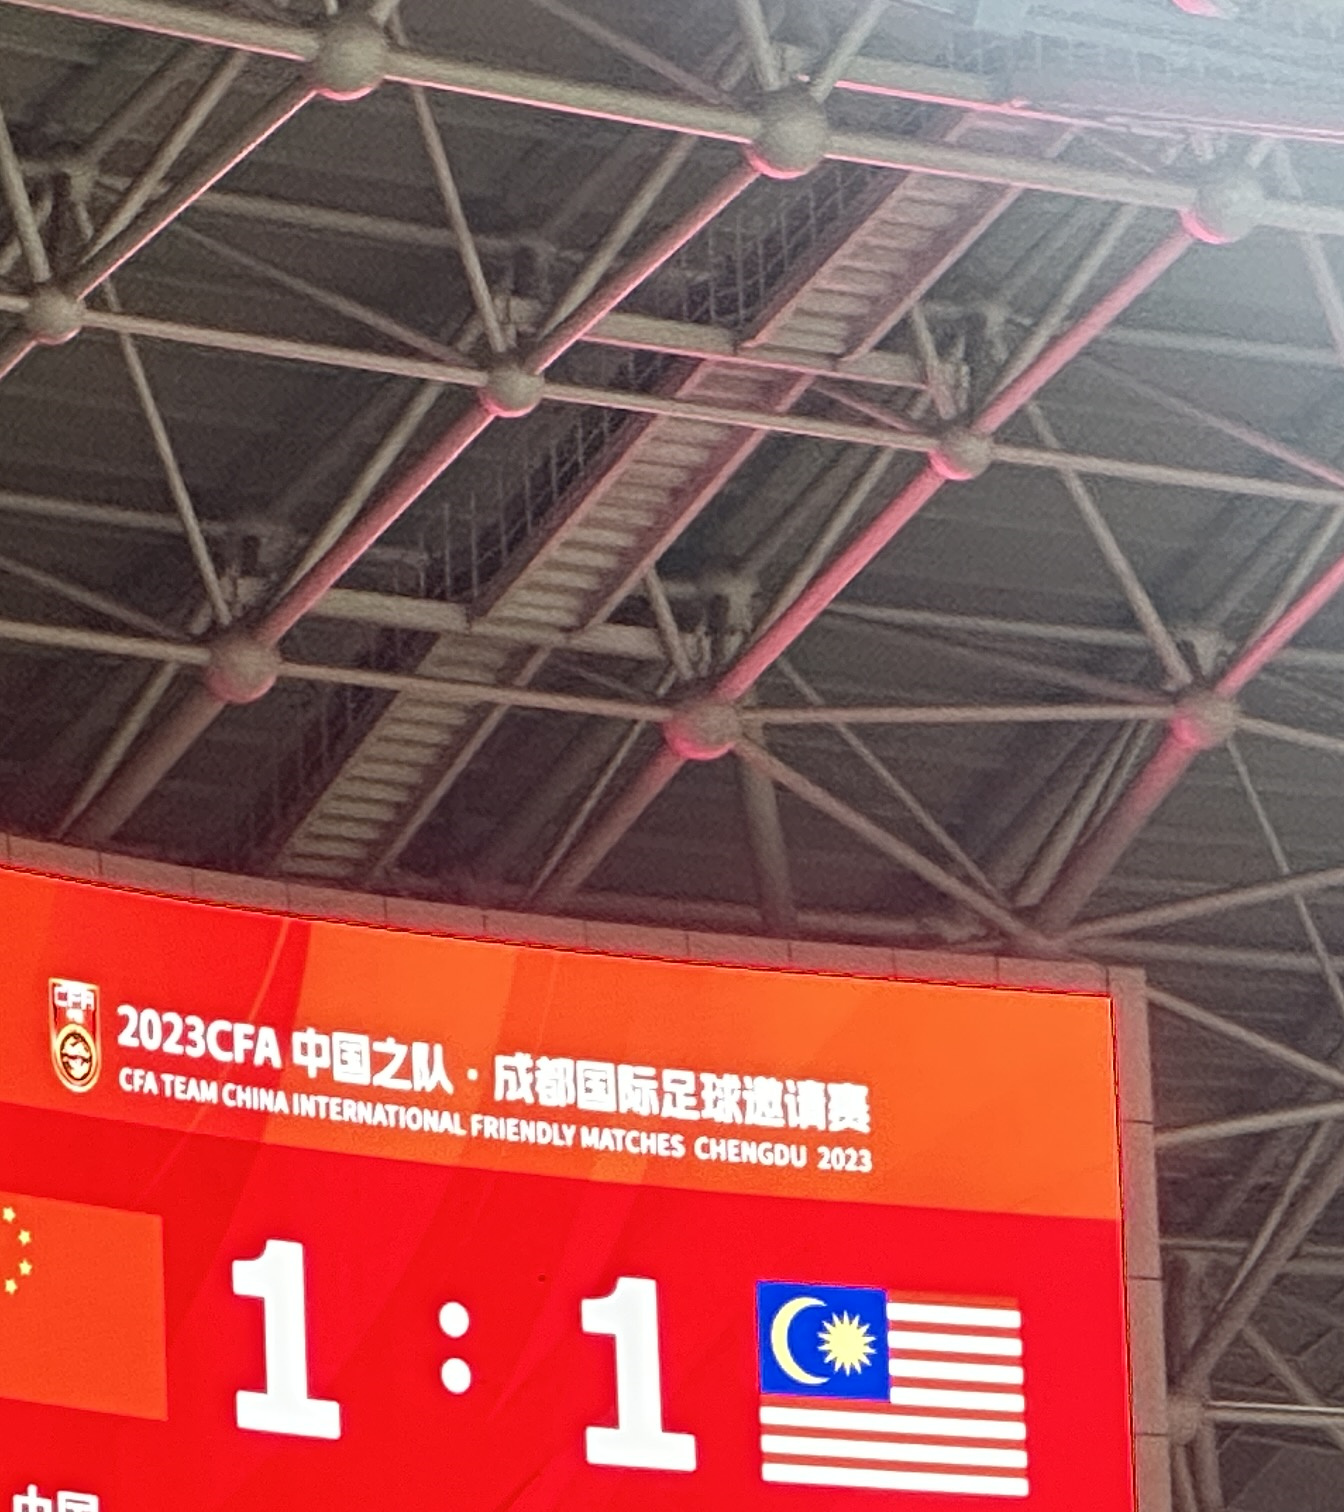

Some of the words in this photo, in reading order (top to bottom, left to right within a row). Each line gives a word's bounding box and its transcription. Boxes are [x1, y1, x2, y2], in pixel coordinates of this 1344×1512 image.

[117, 1004, 283, 1070] 2023CFA
[118, 1067, 159, 1096] CFA
[161, 1074, 219, 1105] TEAM
[221, 1082, 290, 1116] CHINA
[292, 1093, 467, 1137] INTERNATIONAL
[470, 1113, 577, 1148] FRIENDLY
[580, 1126, 686, 1159] MATCHES
[694, 1135, 808, 1169] CHENGDU
[816, 1145, 874, 1174] 2023
[231, 1238, 342, 1441] 1
[580, 1275, 698, 1473] 1
